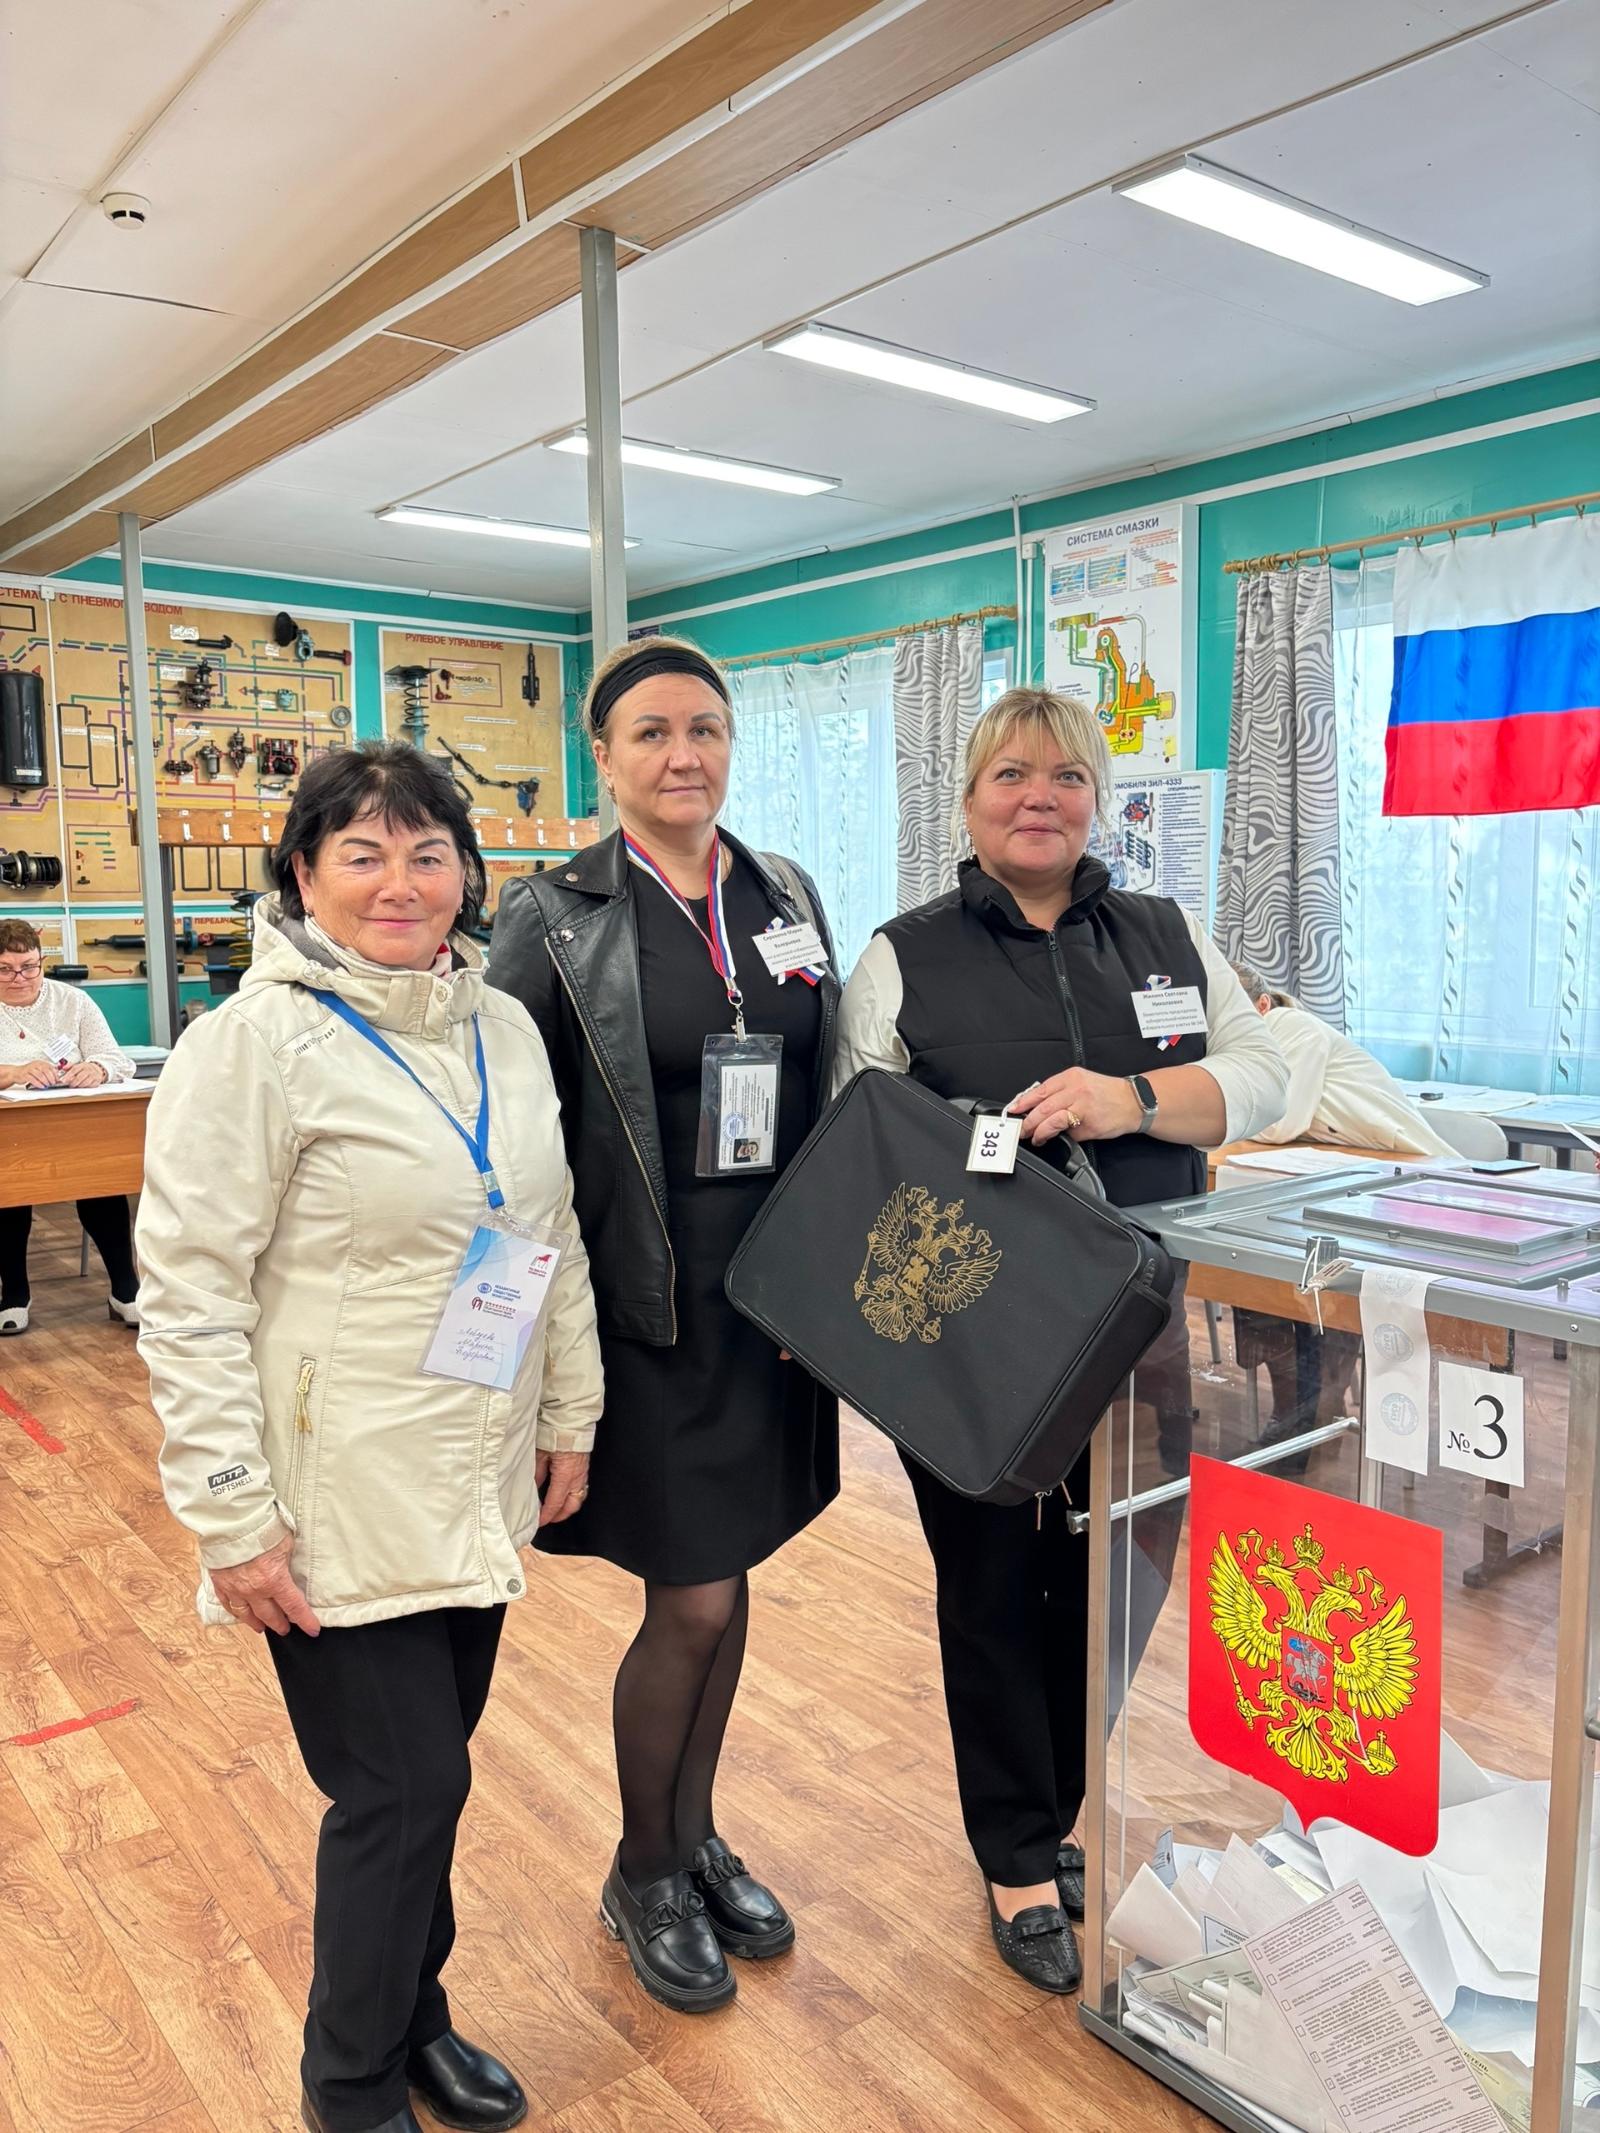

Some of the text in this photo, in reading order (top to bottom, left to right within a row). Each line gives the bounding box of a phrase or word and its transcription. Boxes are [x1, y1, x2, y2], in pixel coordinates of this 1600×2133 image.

[1067, 528, 1114, 547] СИСТЕМА
[1115, 517, 1160, 536] СМАЗКИ
[60, 594, 68, 603] С
[72, 594, 183, 615] ПНЕВМОВОДОМ
[405, 633, 504, 651] РУЛЕВОЕ УПРАВЛЕНИЕ
[981, 1130, 1000, 1157] 343
[211, 1475, 254, 1497] SOFTSHELL
[212, 1466, 243, 1485] MTF
